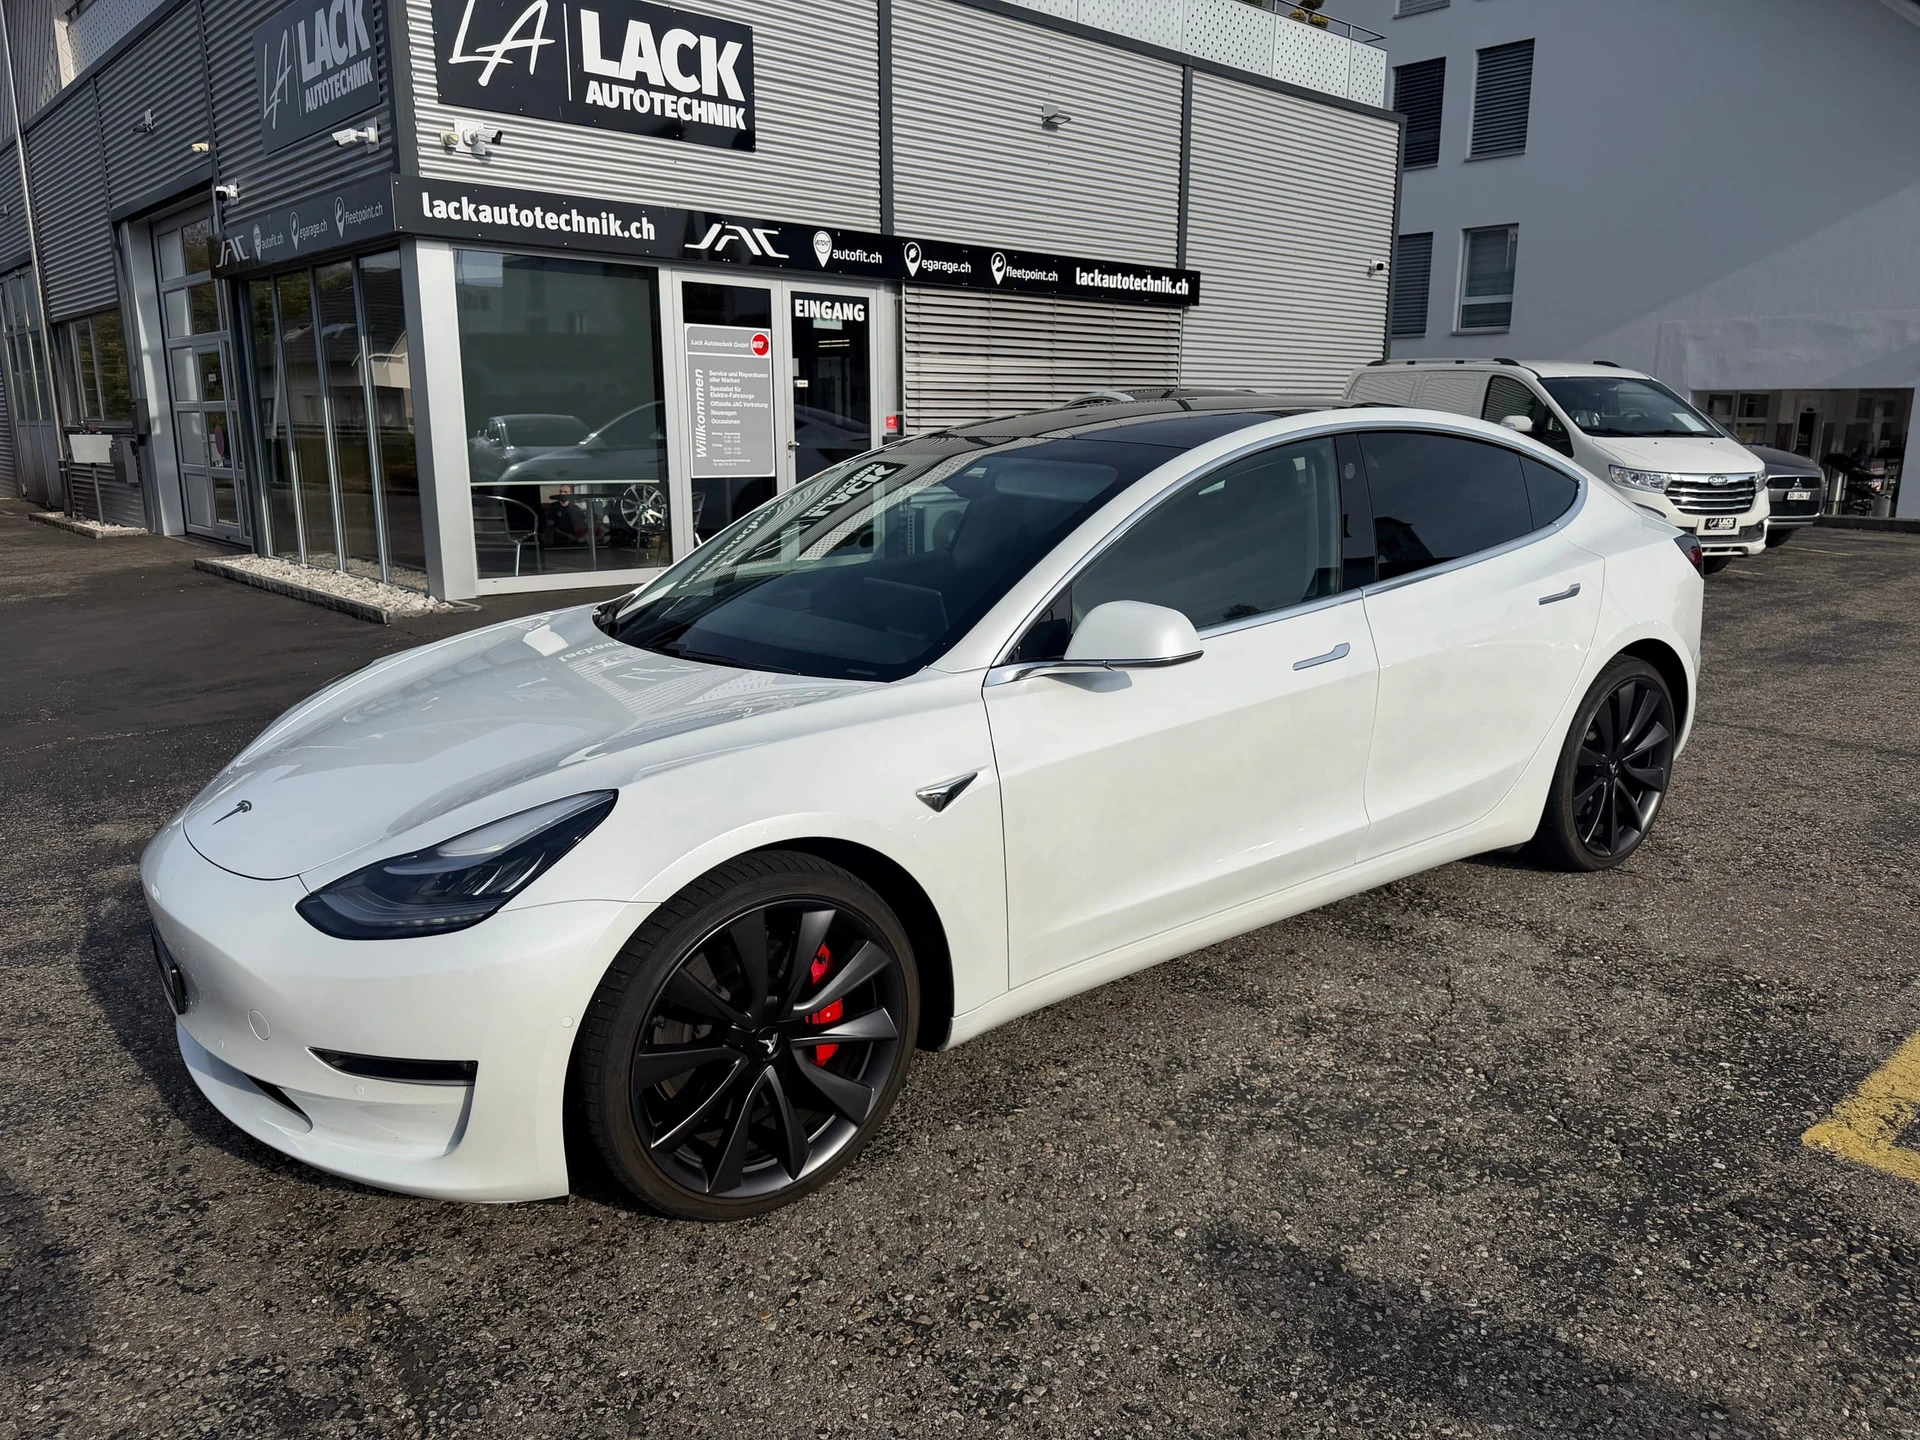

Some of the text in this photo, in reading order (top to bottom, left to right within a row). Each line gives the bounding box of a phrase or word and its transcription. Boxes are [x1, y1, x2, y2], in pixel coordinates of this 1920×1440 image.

[298, 0, 371, 83] LACK
[580, 9, 746, 102] LACK
[305, 56, 373, 114] AUTOTECHNIK
[585, 80, 747, 130] AUTOTECHNIK
[345, 202, 384, 226] fleetpoint.ch
[421, 192, 656, 241] lackautotechnik.ch
[261, 232, 285, 250] autofit.ch
[299, 218, 328, 241] egarage.ch
[684, 223, 790, 259] JAC
[832, 249, 883, 264] autofit.ch
[921, 259, 972, 274] egarage.ch
[1006, 266, 1059, 282] fleetpoint.ch
[1075, 266, 1189, 295] lackautotechnik.ch
[794, 298, 866, 322] EINGANG
[739, 371, 769, 379] Reparaturen
[710, 385, 734, 393] Spezialist
[710, 392, 755, 400] Elektro-Fahrzeuge
[695, 369, 707, 458] Willkommen
